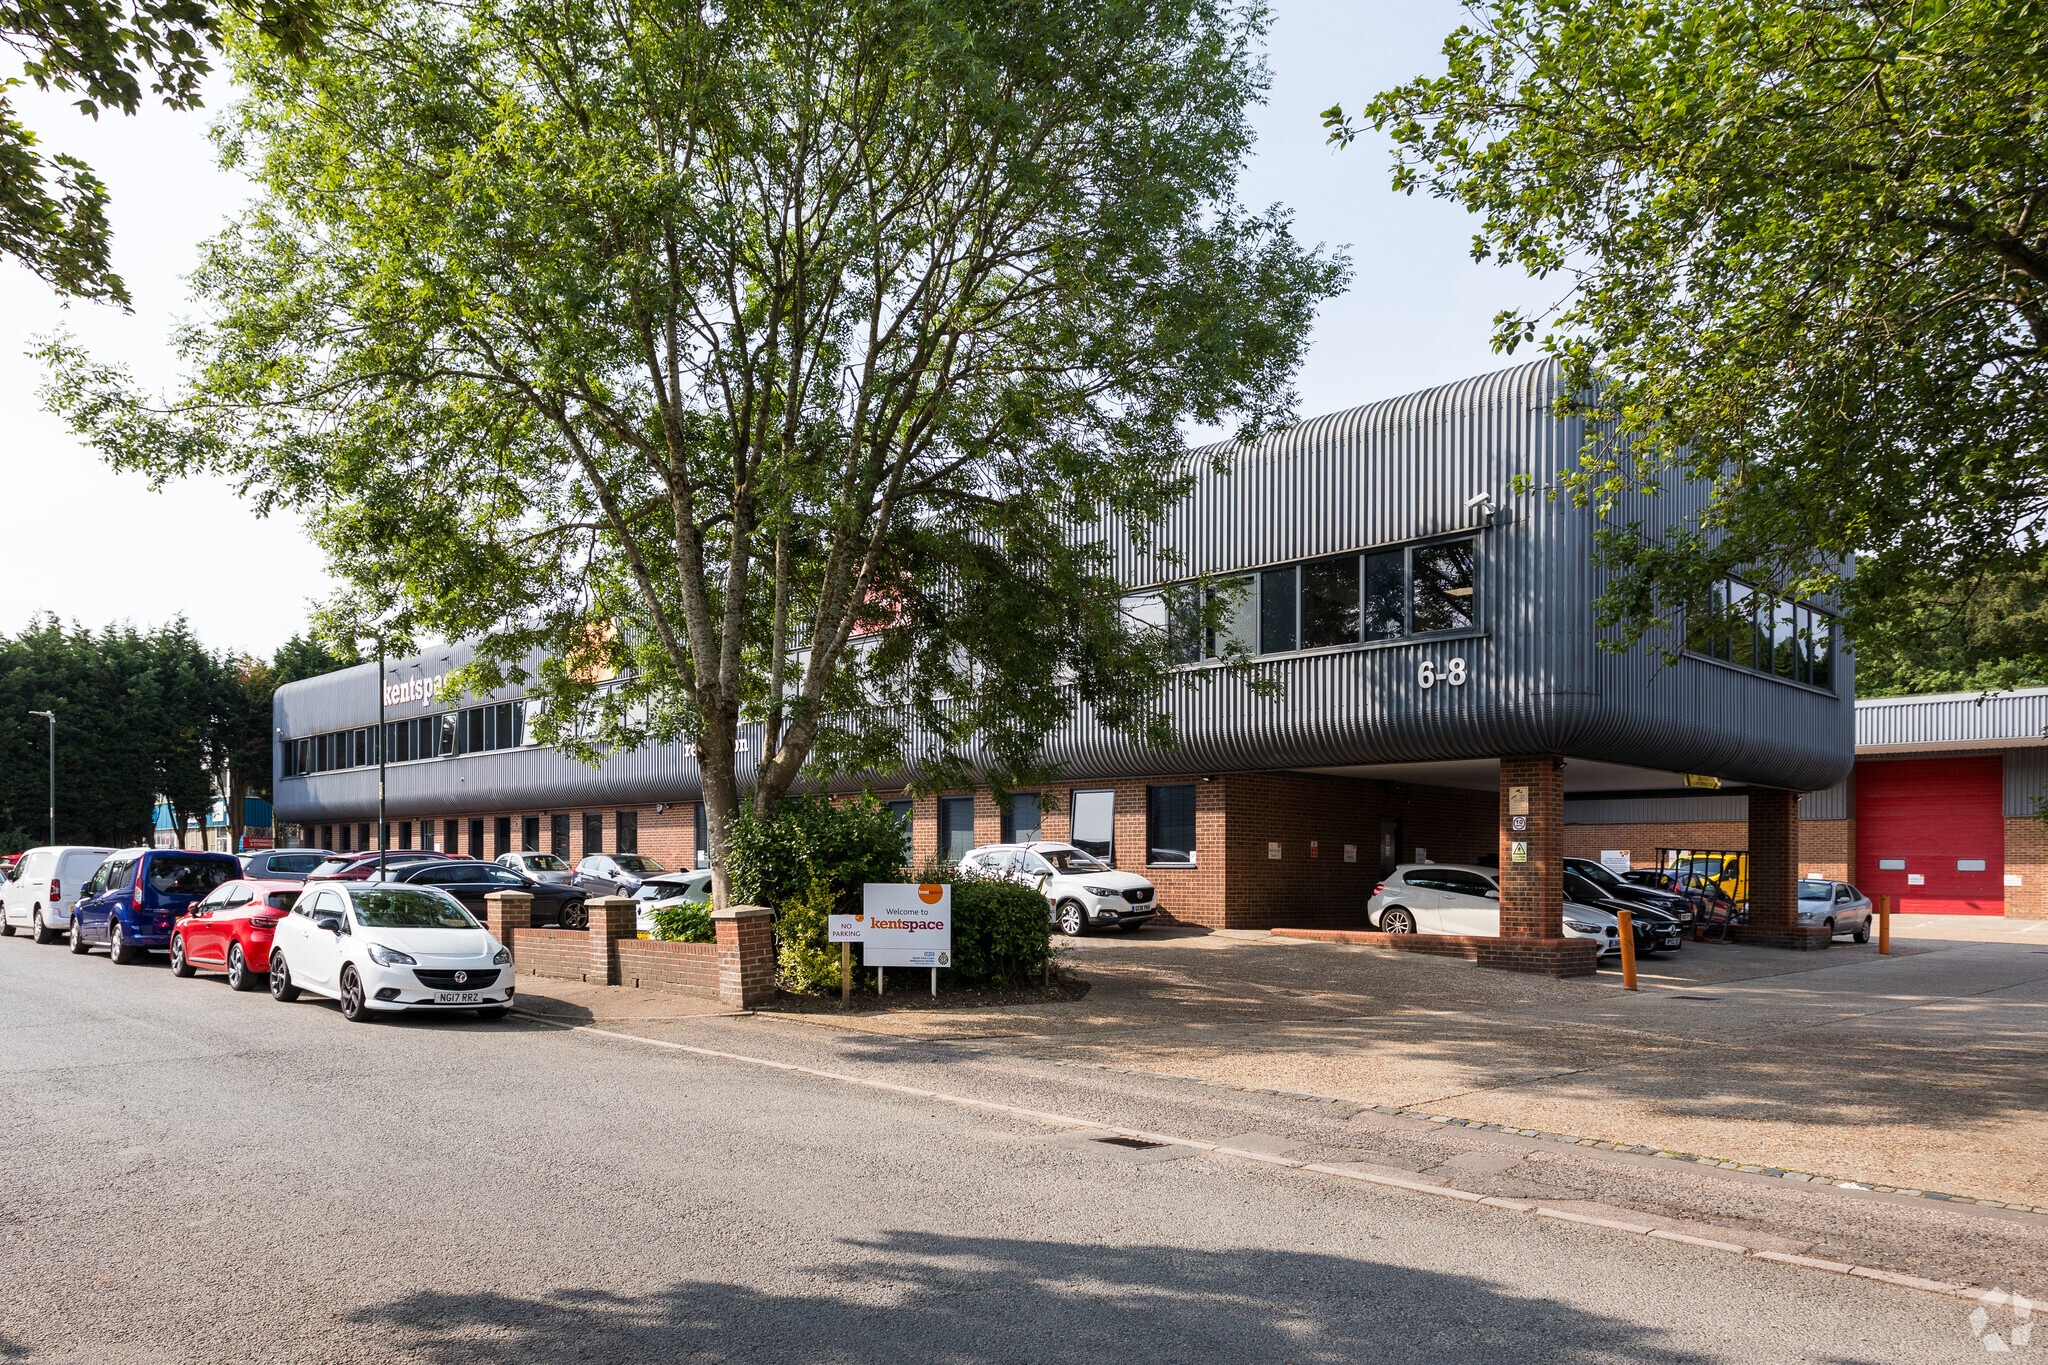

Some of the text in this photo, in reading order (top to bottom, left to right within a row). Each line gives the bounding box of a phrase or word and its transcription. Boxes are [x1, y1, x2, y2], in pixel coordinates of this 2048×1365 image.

[1417, 657, 1467, 689] 6-8
[383, 674, 449, 707] kentspa
[886, 908, 919, 916] Welcome
[870, 917, 944, 933] kentspace
[440, 993, 479, 1002] NG17 RRZ
